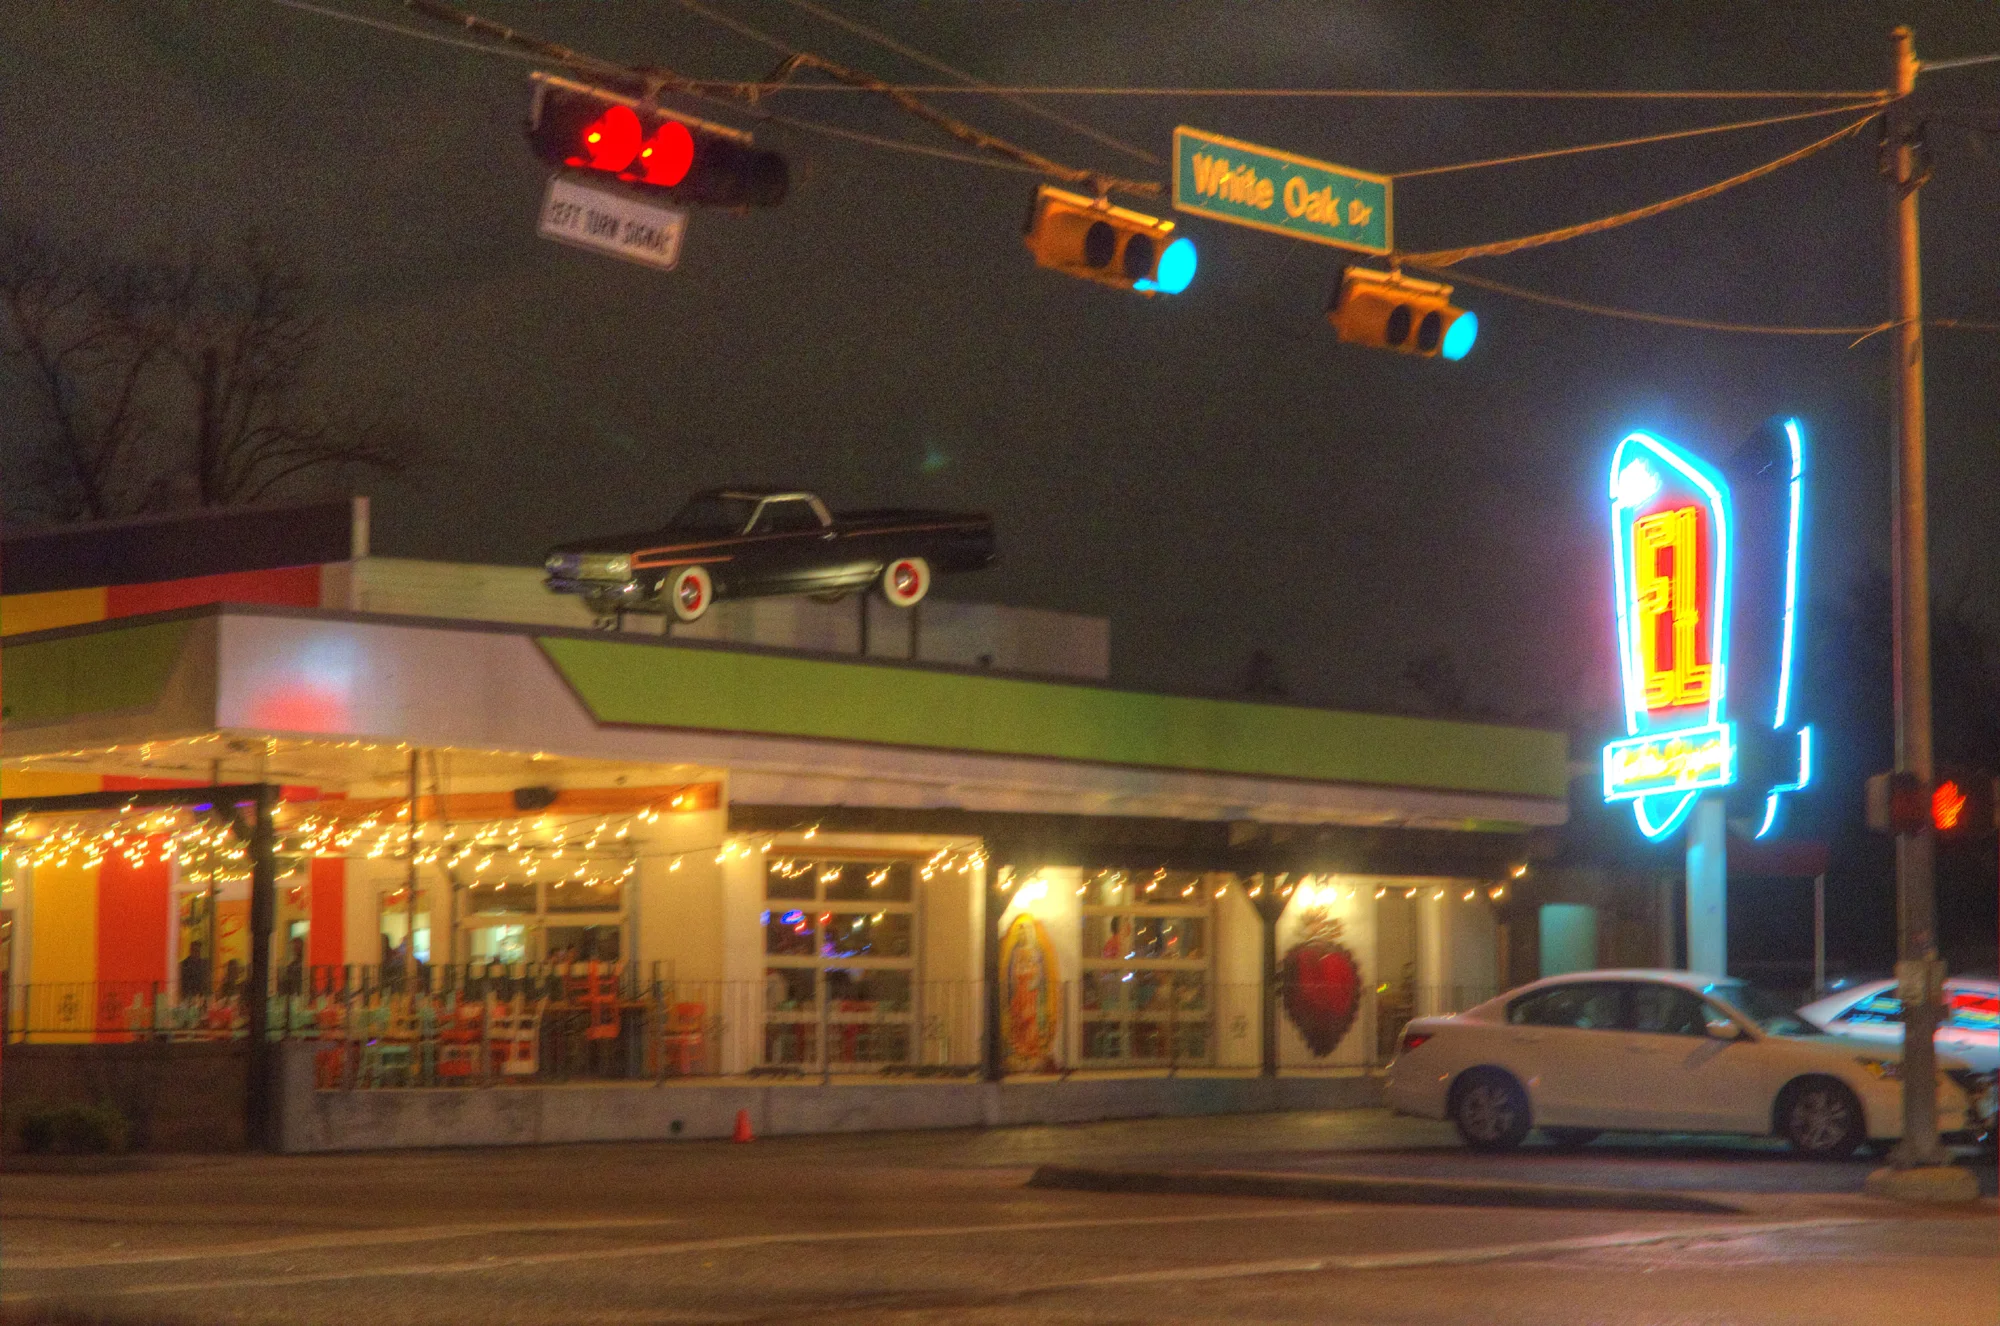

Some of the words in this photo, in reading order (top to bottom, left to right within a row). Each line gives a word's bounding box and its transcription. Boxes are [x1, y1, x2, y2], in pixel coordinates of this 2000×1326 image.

[1192, 152, 1274, 210] White
[1283, 176, 1341, 227] Oak
[1348, 199, 1373, 227] Dr
[550, 201, 582, 230] LEFT
[585, 209, 620, 238] TURN
[623, 221, 671, 254] SIGNAL
